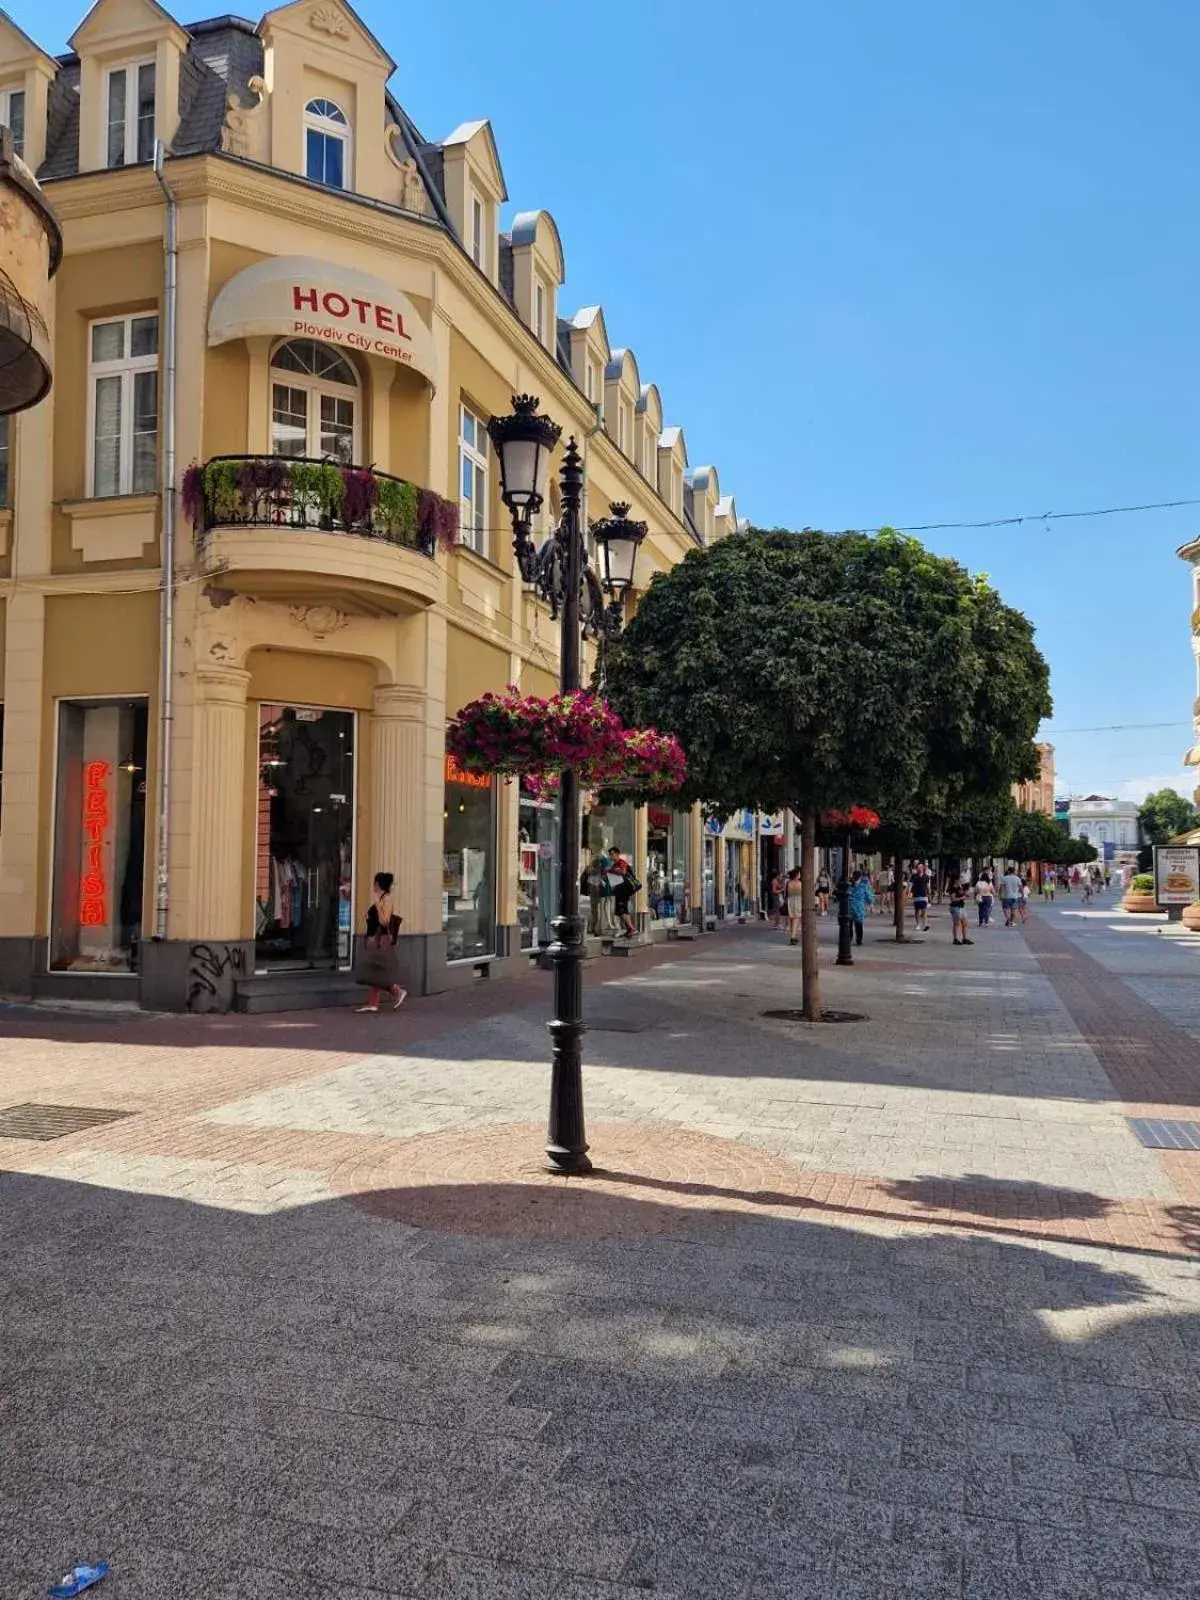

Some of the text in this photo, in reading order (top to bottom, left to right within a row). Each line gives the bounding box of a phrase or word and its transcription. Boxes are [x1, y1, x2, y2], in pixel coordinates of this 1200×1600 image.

[293, 286, 412, 341] HOTEL
[294, 321, 412, 362] Plovdiv City Center
[81, 762, 109, 927] FETISH
